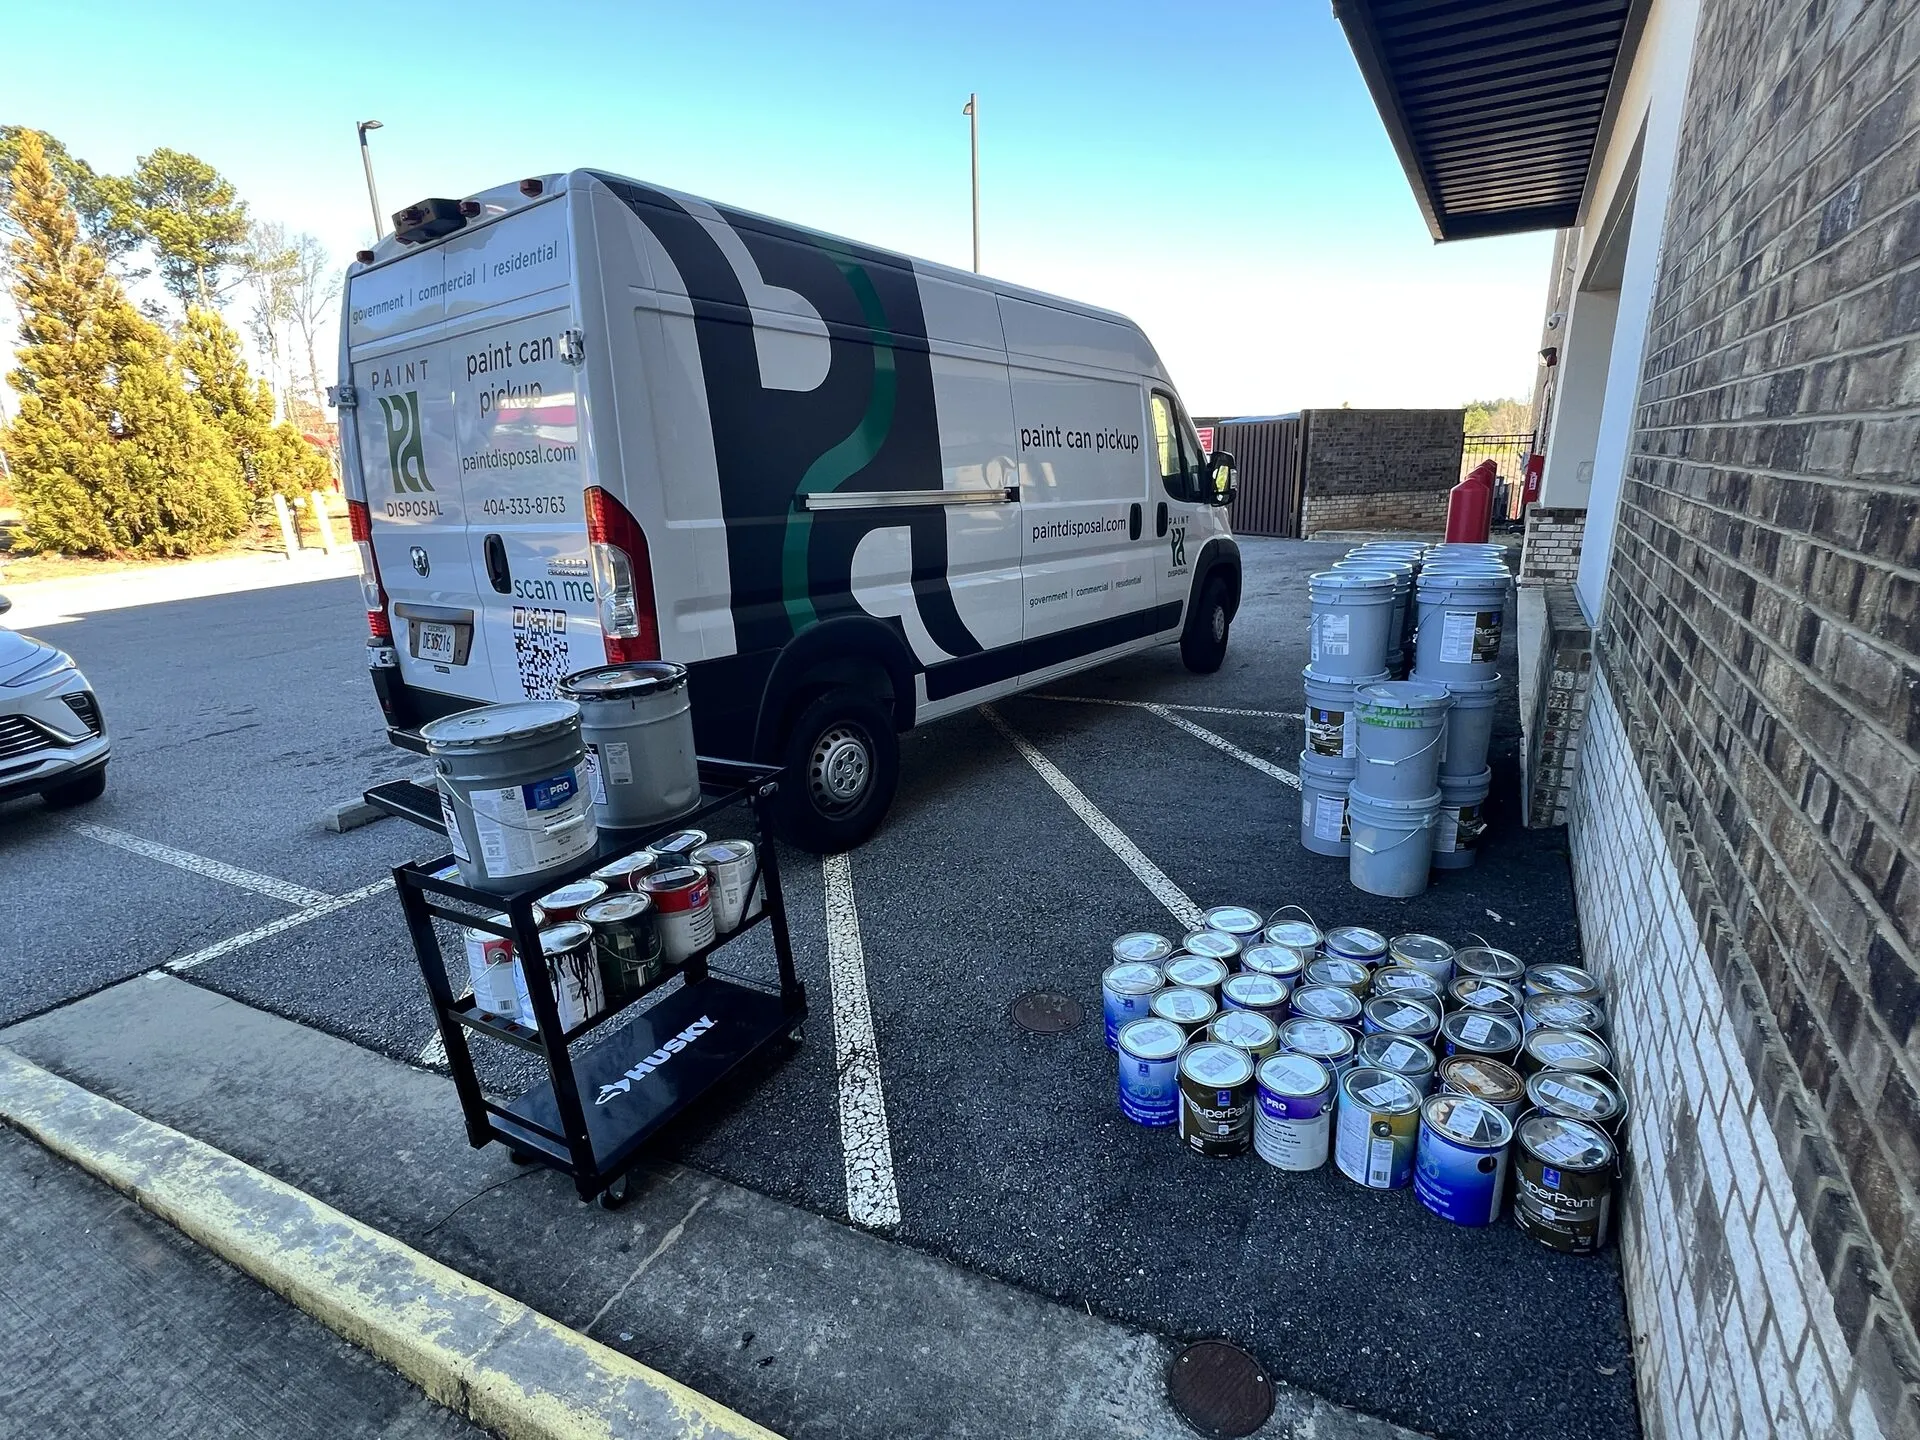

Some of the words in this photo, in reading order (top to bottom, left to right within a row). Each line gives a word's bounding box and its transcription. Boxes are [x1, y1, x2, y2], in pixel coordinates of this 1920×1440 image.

[353, 294, 404, 325] government
[418, 269, 476, 302] commercial
[493, 240, 558, 277] residential
[466, 341, 512, 381] paint
[519, 336, 553, 364] can
[371, 359, 429, 391] PAINT
[479, 380, 543, 418] pickup
[1020, 424, 1062, 452] paint
[1066, 431, 1092, 449] can
[1096, 428, 1139, 454] pickup
[462, 444, 576, 474] paintdisposal.com
[387, 500, 444, 518] DISPOSAL
[483, 496, 566, 516] 404-333-8763
[1168, 515, 1189, 525] PAINT
[1032, 517, 1126, 543] paintdisposal.com
[1168, 567, 1189, 578] DISPOSAL
[514, 577, 558, 600] scan
[563, 580, 595, 602] me
[1029, 590, 1068, 608] government
[1076, 582, 1109, 597] commercial
[1116, 575, 1142, 589] residential
[549, 781, 570, 796] PRO
[623, 1015, 715, 1081] HUSKY
[1266, 1097, 1287, 1111] PRO
